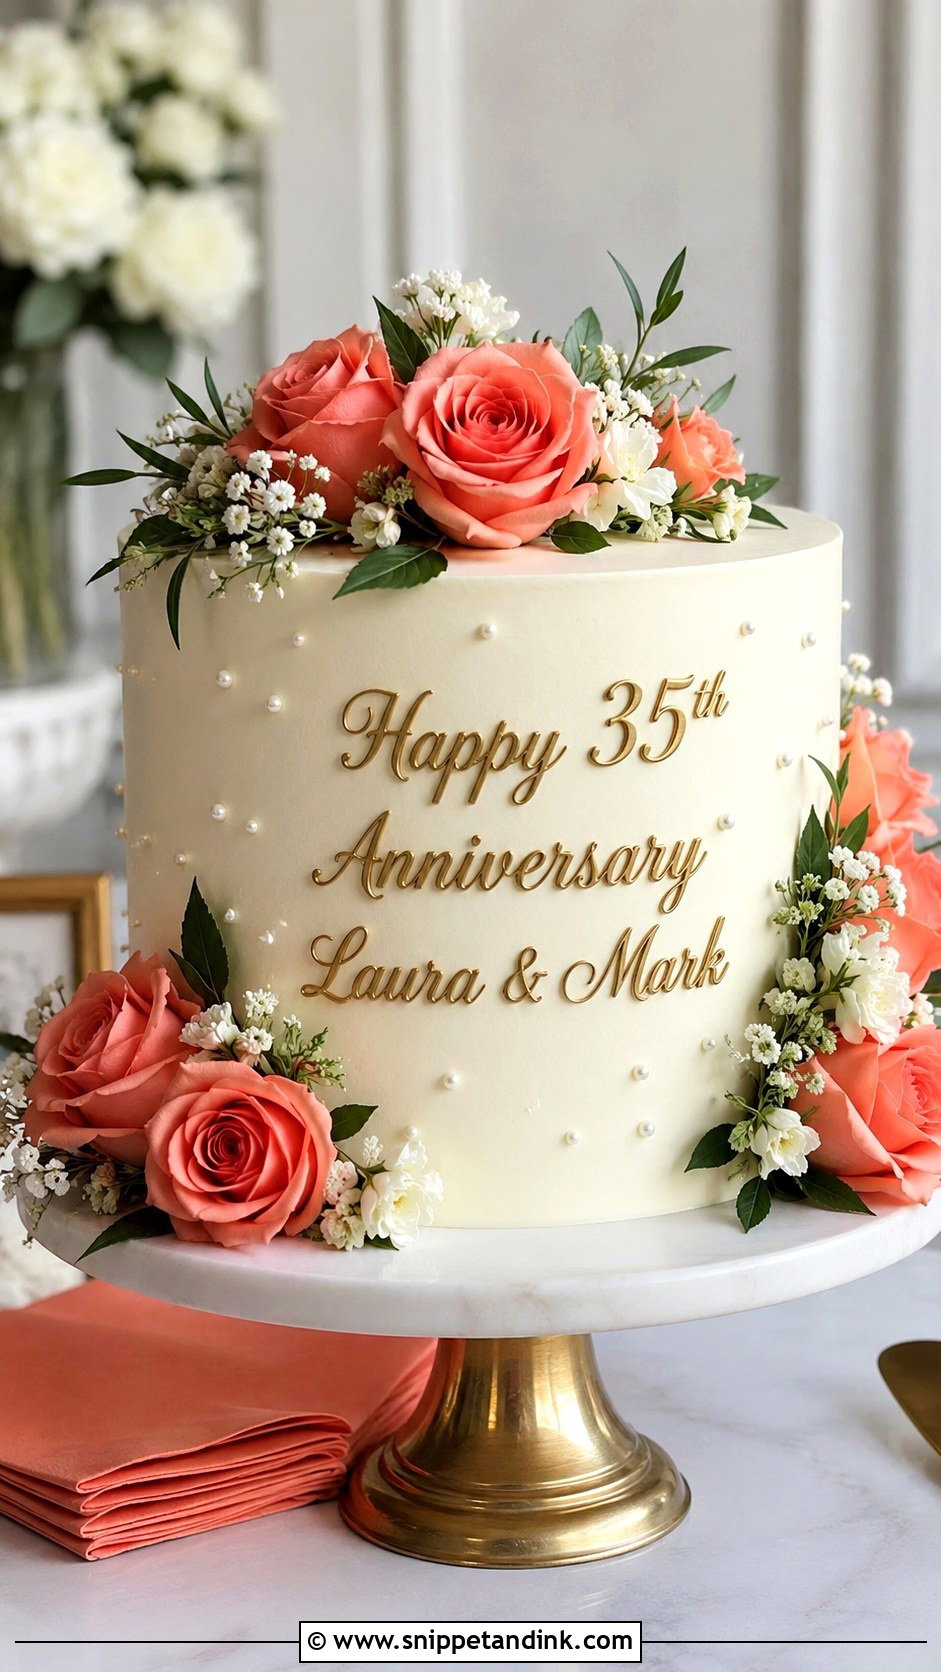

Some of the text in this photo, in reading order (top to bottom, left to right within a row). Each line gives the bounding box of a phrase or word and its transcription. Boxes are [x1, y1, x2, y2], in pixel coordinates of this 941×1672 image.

[341, 669, 729, 804] Happy 35th
[312, 810, 707, 914] Anniversary
[300, 915, 730, 1004] Laura & Mark
